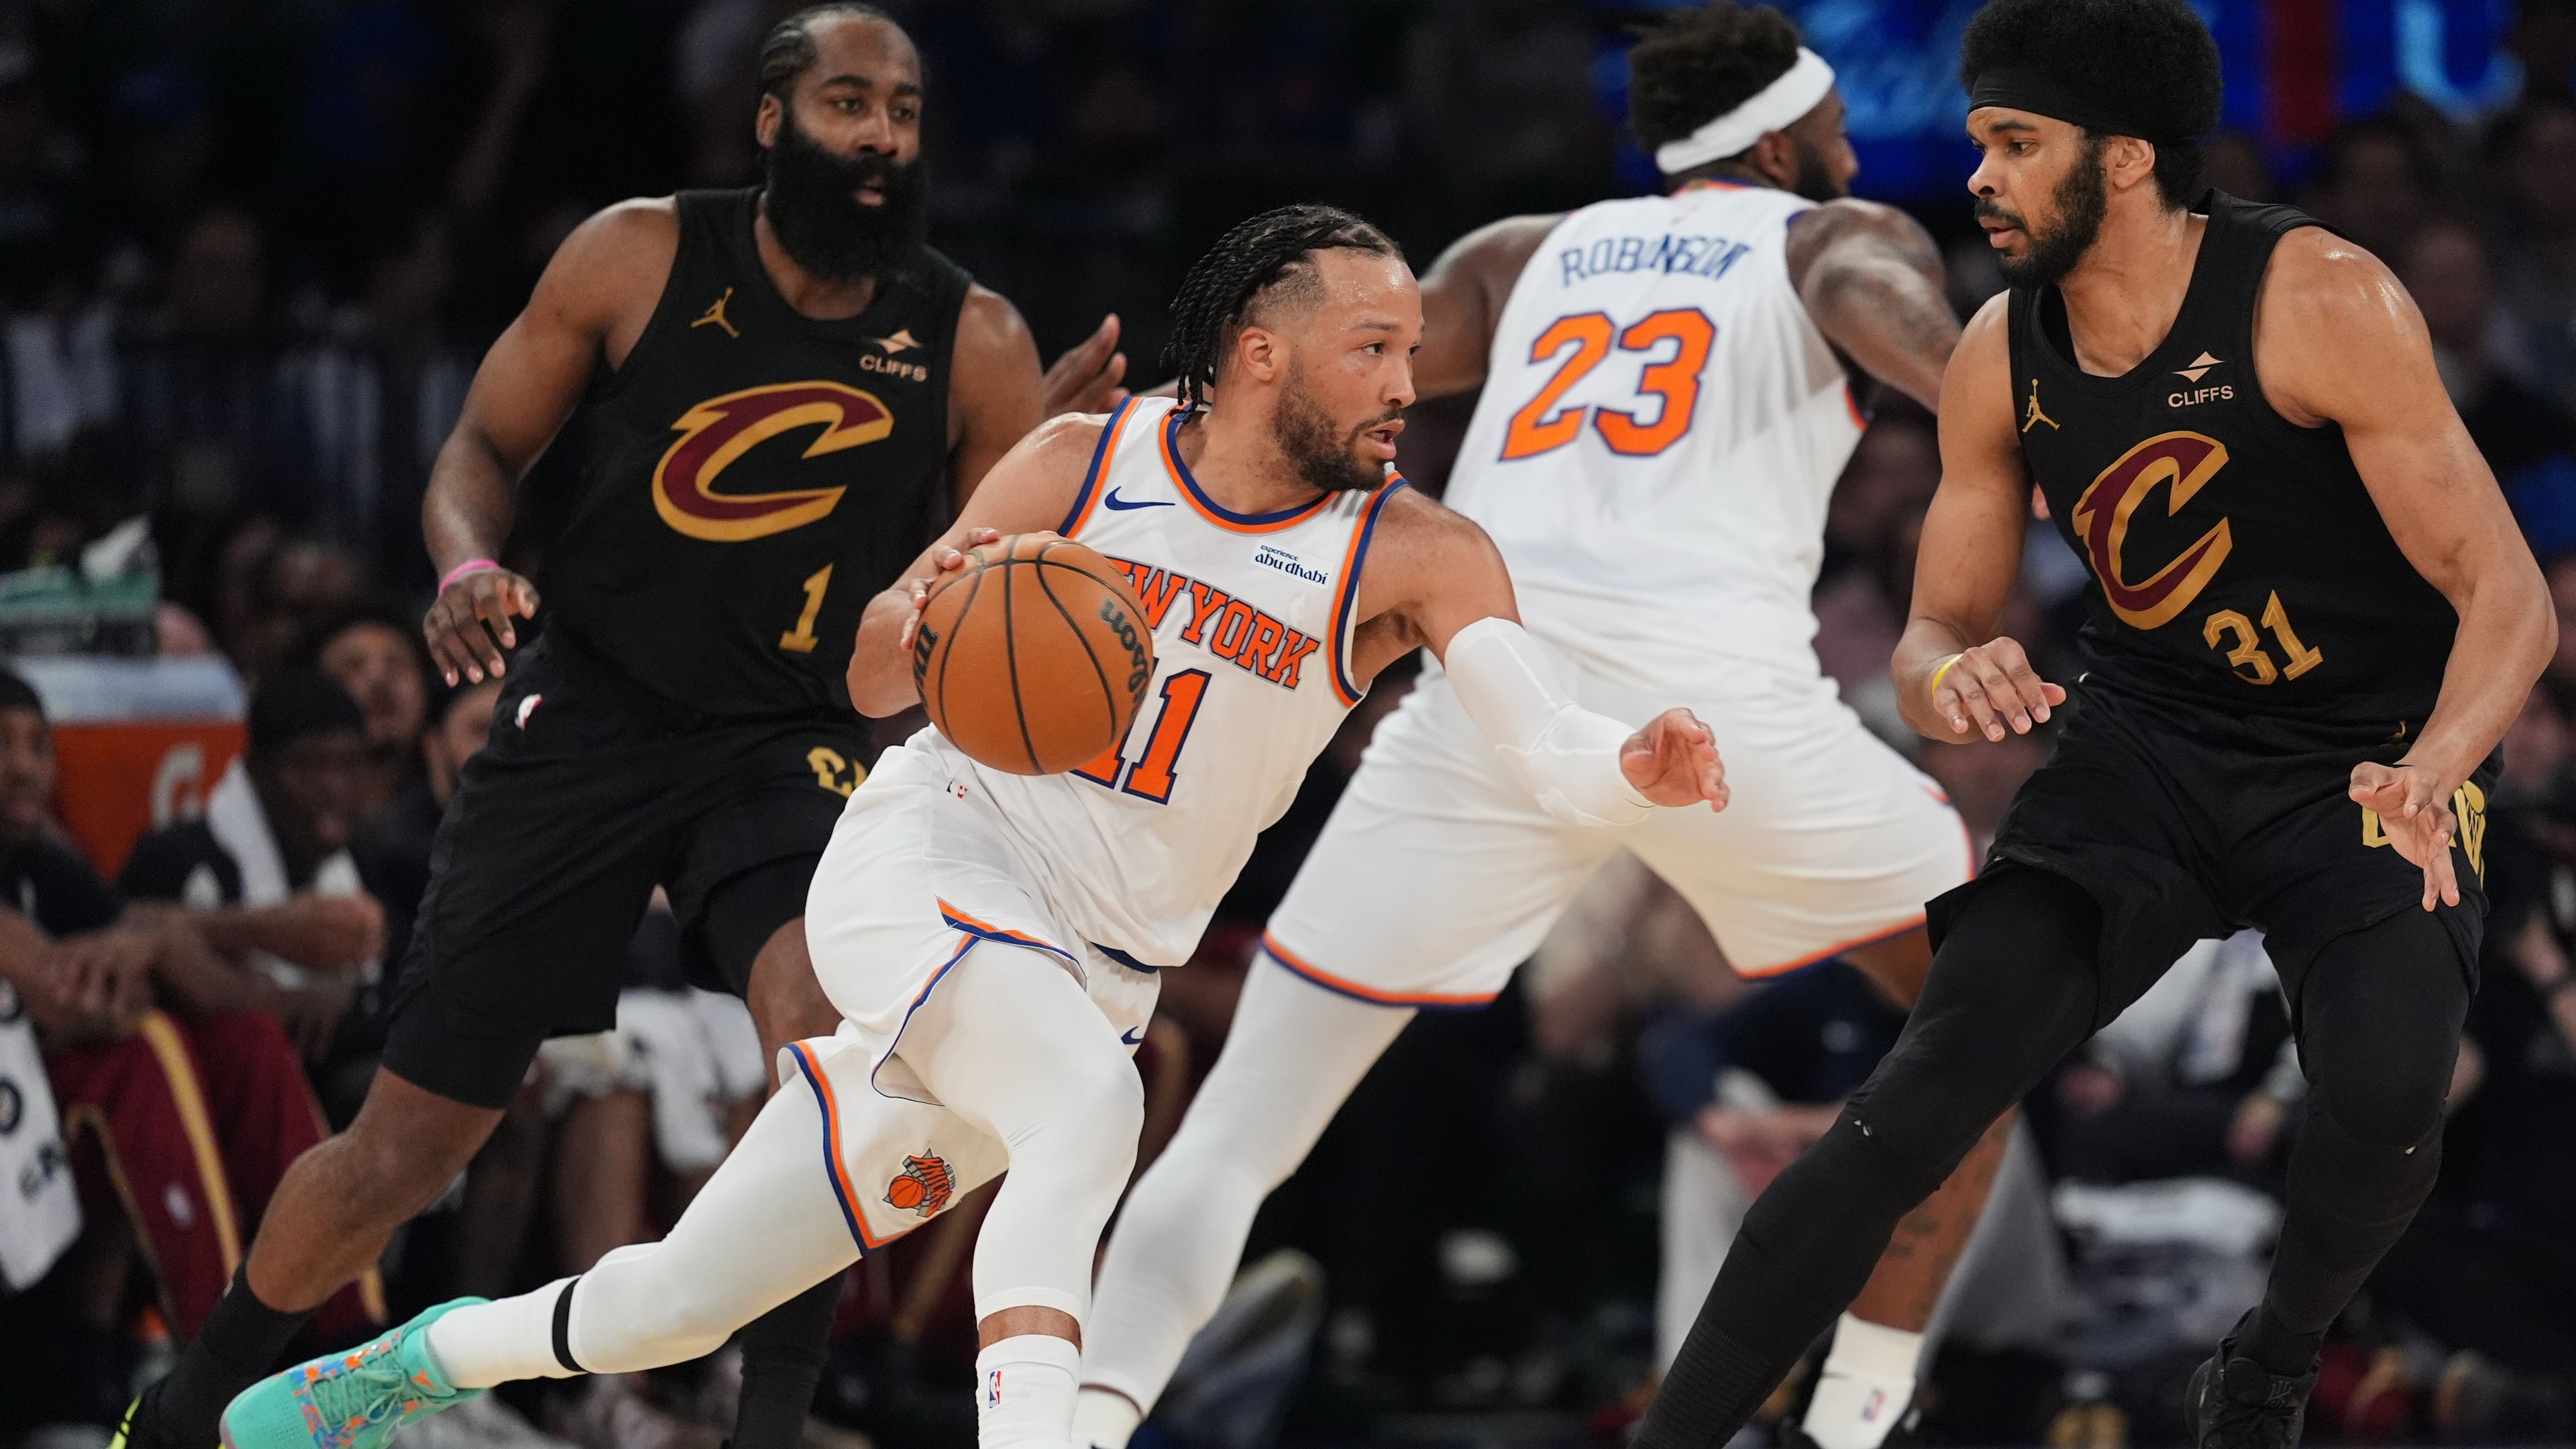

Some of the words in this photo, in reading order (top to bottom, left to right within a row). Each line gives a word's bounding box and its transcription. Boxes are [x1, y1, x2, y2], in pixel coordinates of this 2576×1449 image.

[859, 354, 927, 382] CLIFFS
[1497, 307, 1717, 462] 23
[2167, 384, 2234, 408] CLIFFS
[1255, 553, 1284, 570] abu
[1260, 544, 1299, 561] experience
[778, 562, 835, 653] 1
[1178, 574, 1322, 691] YORK
[2202, 588, 2324, 686] 31
